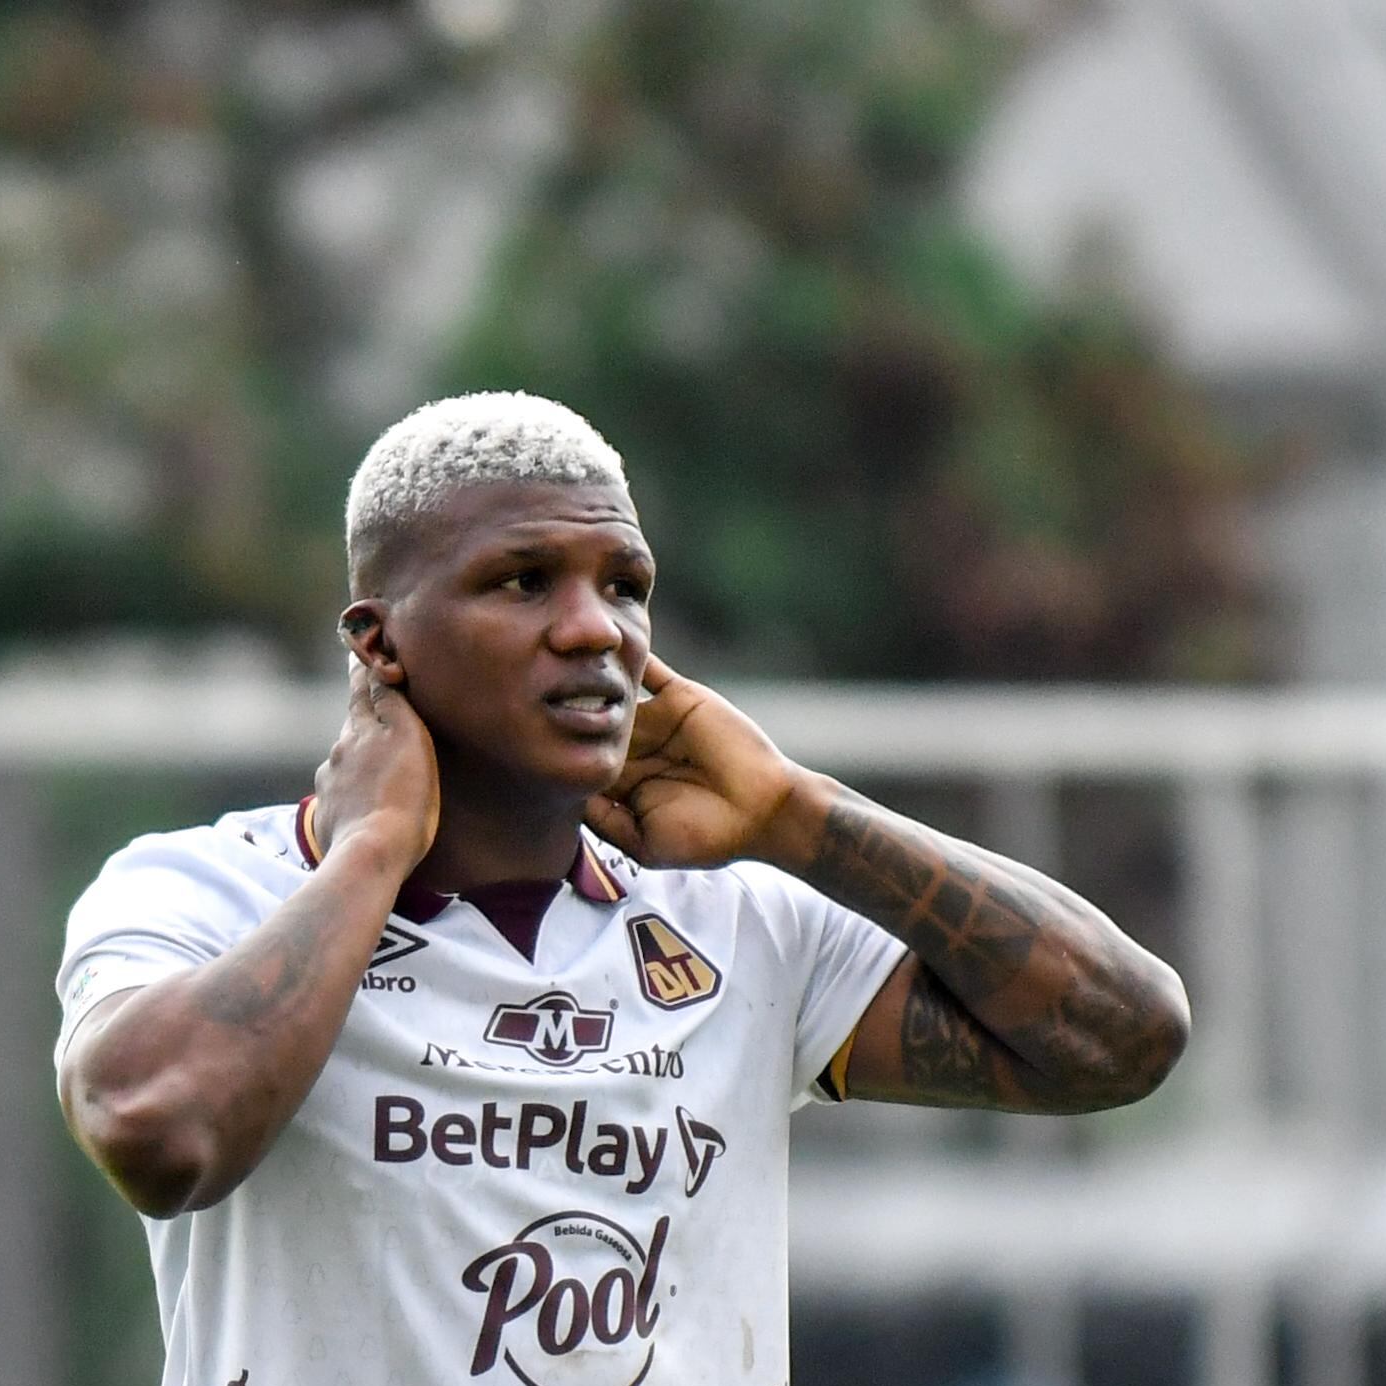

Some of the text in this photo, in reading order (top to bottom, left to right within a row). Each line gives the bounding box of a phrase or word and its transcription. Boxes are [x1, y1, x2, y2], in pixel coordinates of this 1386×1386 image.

[362, 972, 416, 993] bro
[528, 1009, 578, 1052] M
[374, 1095, 668, 1195] BetPlay
[554, 1225, 632, 1262] Bebida Gaseosa
[462, 1215, 670, 1376] Pool
